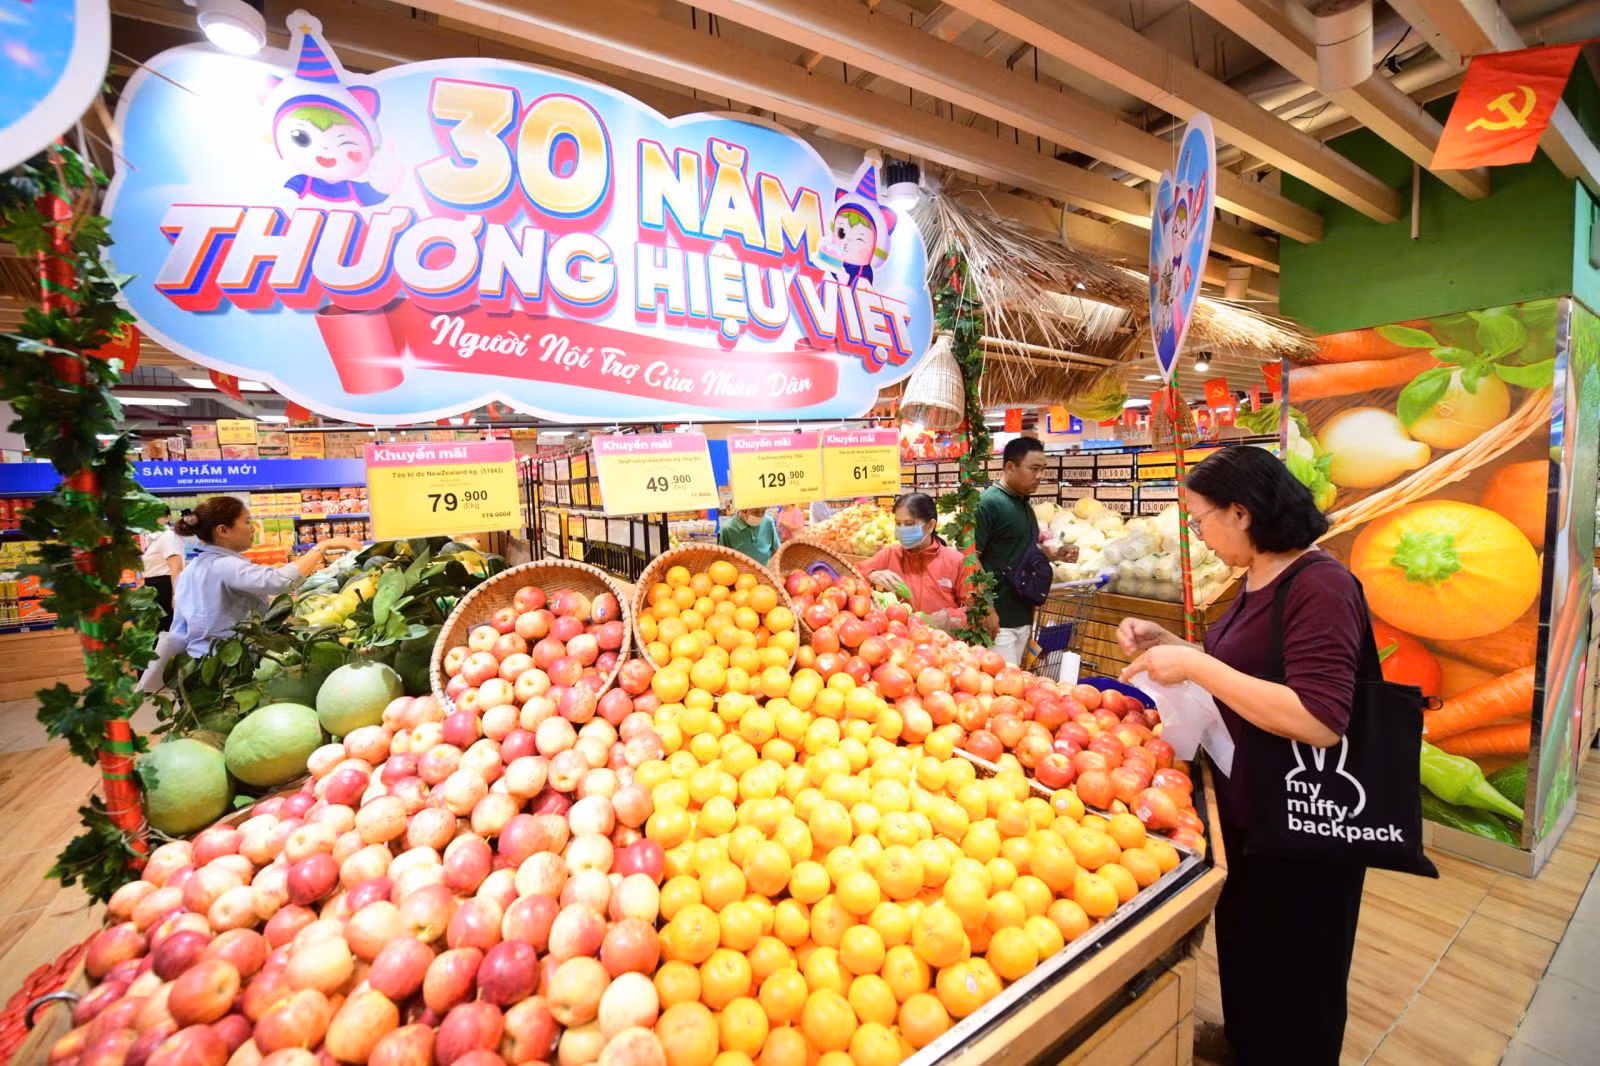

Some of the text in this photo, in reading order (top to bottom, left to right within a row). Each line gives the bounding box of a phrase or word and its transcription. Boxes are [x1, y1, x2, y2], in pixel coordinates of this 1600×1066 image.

[415, 78, 825, 262] 30 NĂM
[155, 204, 912, 364] THƯƠNG HIỆU VIỆT
[430, 314, 530, 358] Người
[539, 333, 591, 371] Nội
[600, 347, 640, 384] Trợ
[644, 361, 695, 393] Của
[768, 371, 812, 397] Dân
[602, 438, 673, 452] Khuyến mãi
[734, 436, 791, 450] Khuyến mãi
[826, 433, 875, 445] Khuyến mãi
[373, 446, 467, 463] Khuyến mãi
[143, 465, 173, 476] SẢN
[228, 464, 257, 475] MỚI
[1286, 779, 1322, 800] my
[1287, 798, 1348, 823] miffy
[1287, 813, 1405, 843] backpack
